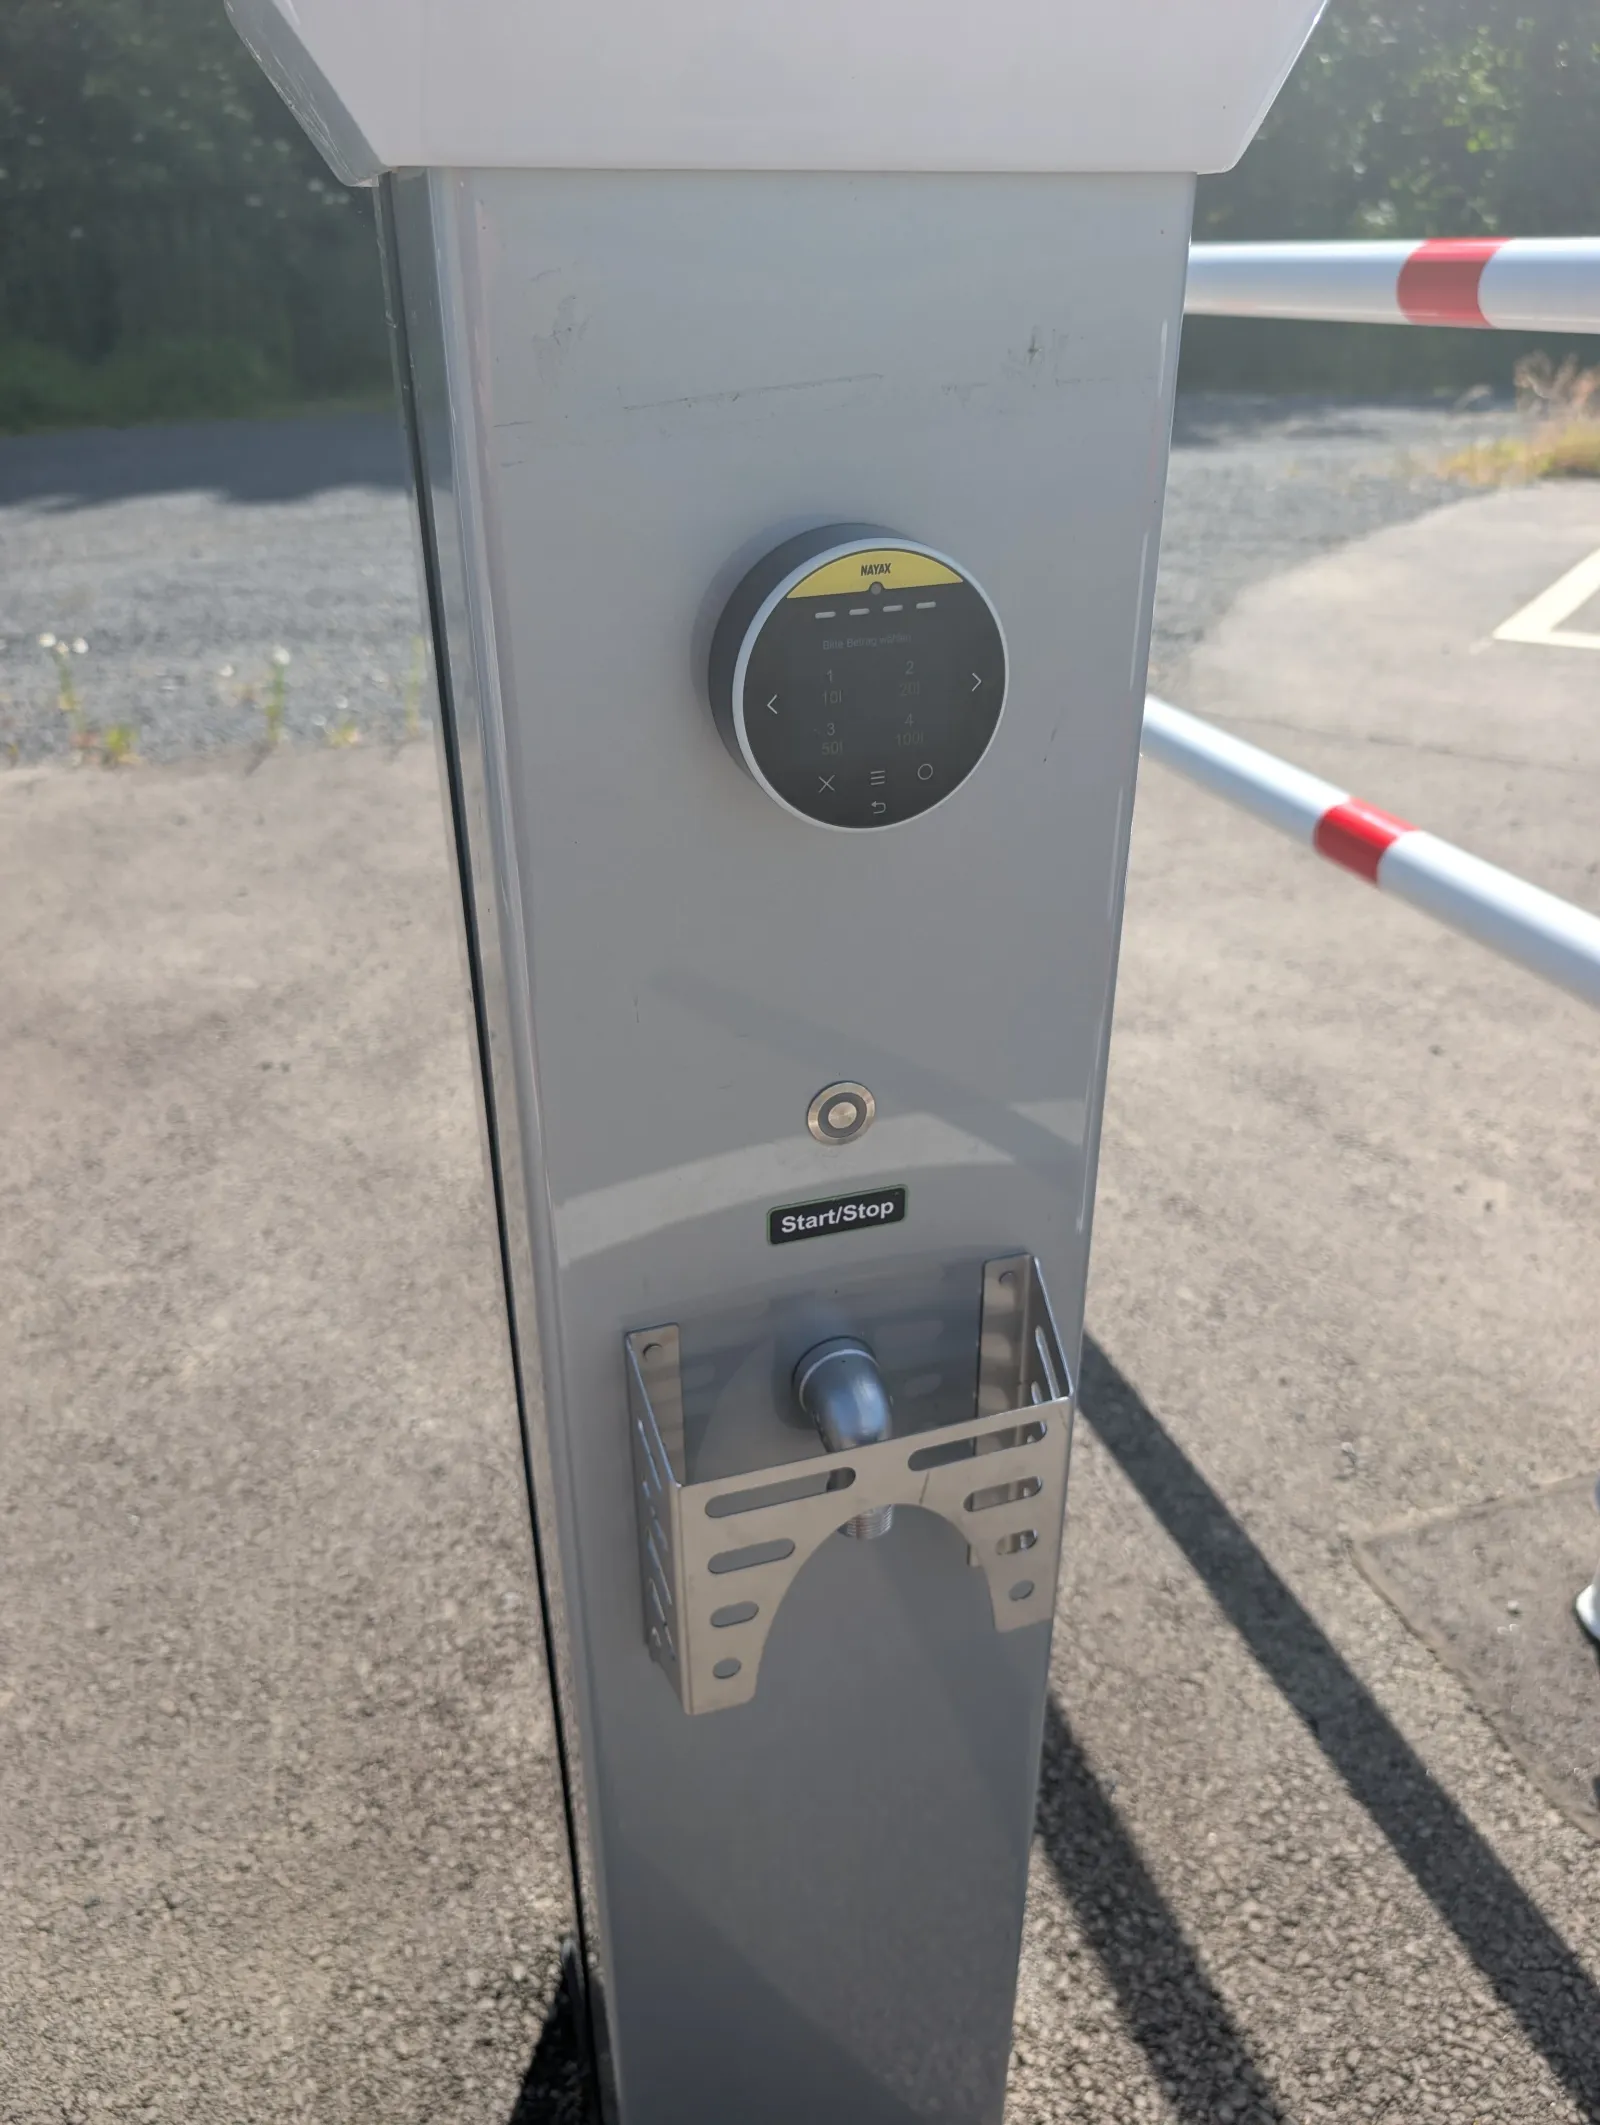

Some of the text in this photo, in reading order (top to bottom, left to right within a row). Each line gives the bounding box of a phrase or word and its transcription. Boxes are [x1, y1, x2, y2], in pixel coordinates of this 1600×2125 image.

[860, 563, 892, 576] NAYAX
[905, 660, 914, 675] 2
[826, 668, 833, 683] 1
[904, 713, 914, 728] 4
[826, 722, 836, 736] 3
[781, 1201, 895, 1233] Start/Stop
